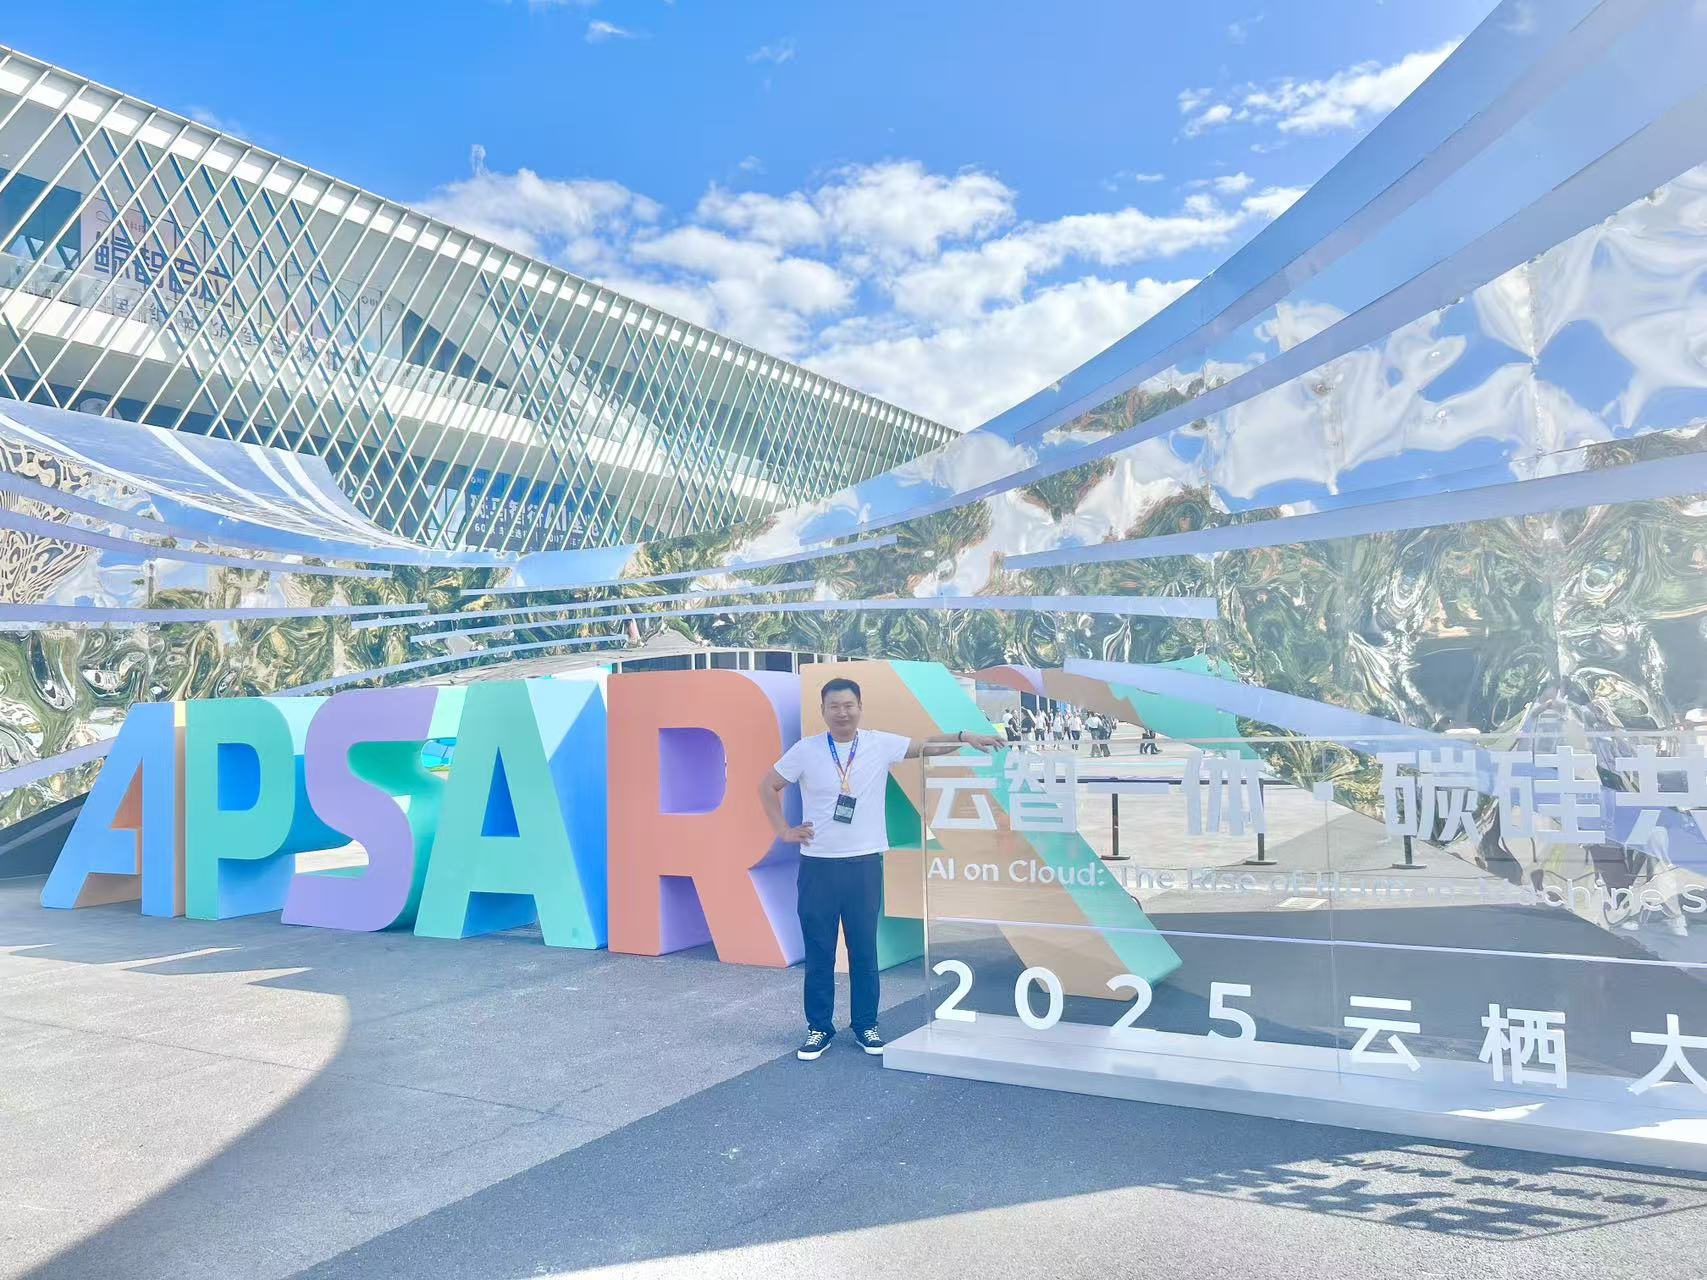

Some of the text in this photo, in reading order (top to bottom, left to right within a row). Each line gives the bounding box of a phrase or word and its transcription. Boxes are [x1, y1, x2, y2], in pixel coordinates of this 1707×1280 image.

[927, 857, 956, 880] AI
[963, 863, 1000, 881] on
[1008, 859, 1105, 886] Cloud:
[1113, 865, 1174, 889] The
